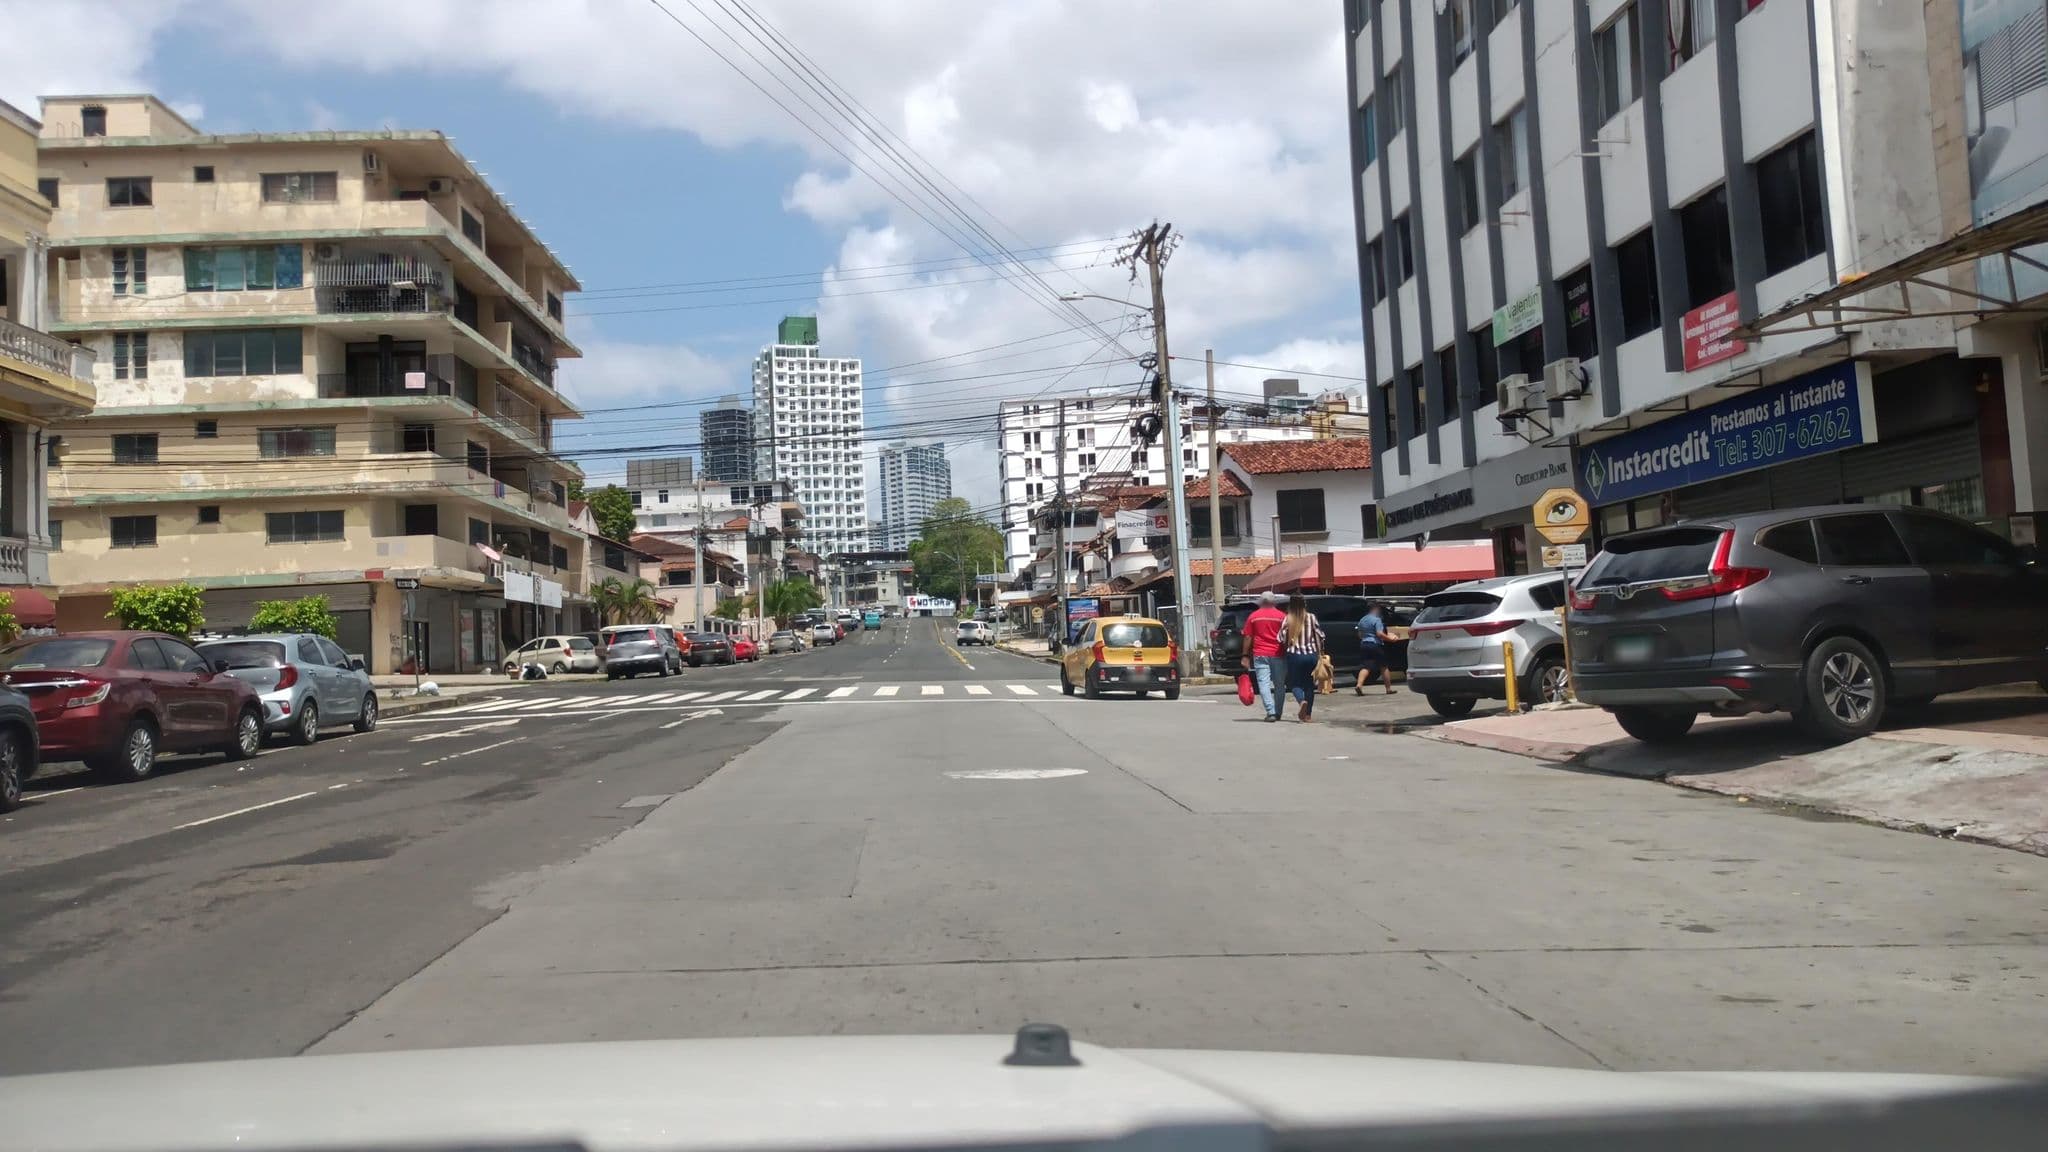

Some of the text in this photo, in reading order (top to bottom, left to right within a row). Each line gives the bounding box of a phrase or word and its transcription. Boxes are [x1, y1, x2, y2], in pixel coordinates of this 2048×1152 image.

[1711, 378, 1846, 435] Prestamos al instante
[1608, 430, 1711, 485] Instacredit
[1715, 406, 1851, 467] Tel: 307-6262
[1117, 519, 1154, 529] Finacredit
